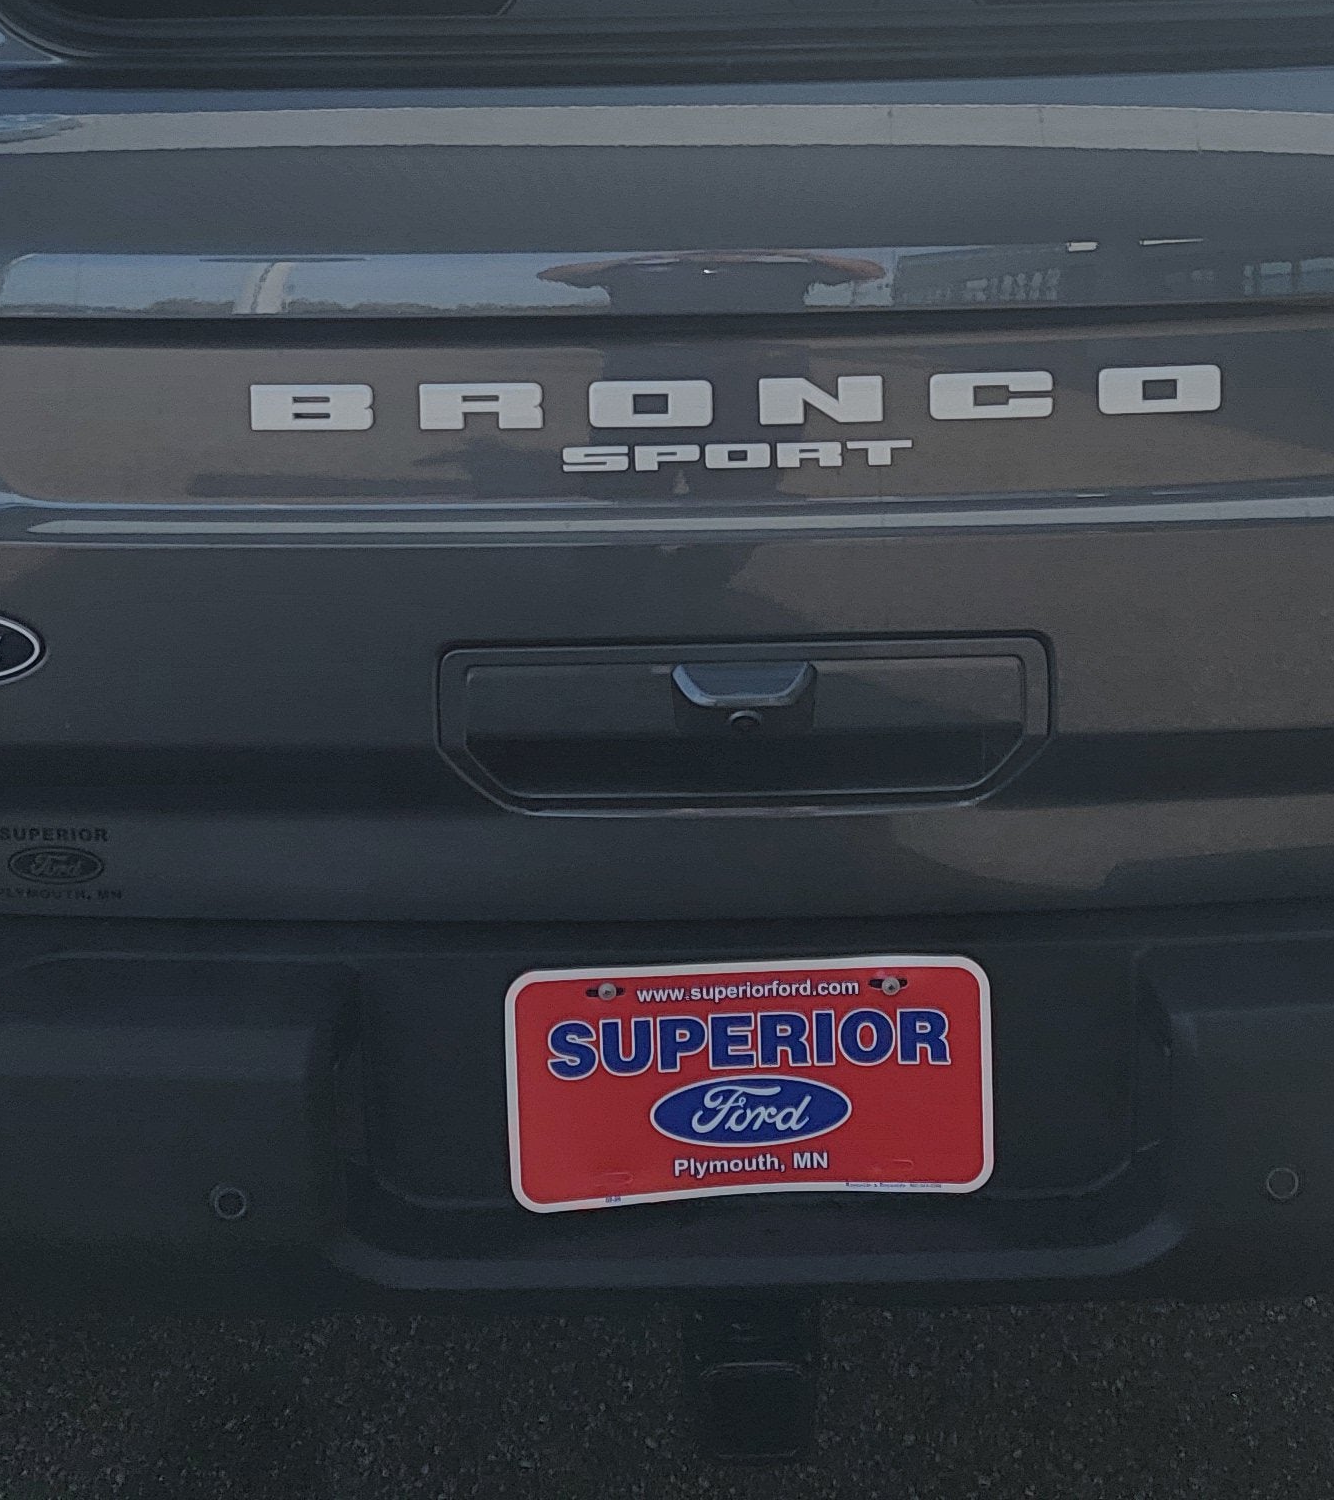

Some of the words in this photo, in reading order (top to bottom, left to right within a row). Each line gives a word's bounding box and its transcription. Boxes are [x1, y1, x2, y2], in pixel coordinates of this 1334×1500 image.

[247, 363, 1223, 431] BRONCO
[560, 438, 914, 473] SPORT
[636, 978, 860, 1004] www.superiorford.com
[547, 1008, 951, 1081] SUPERIOR
[691, 1085, 812, 1134] Ford
[674, 1153, 786, 1179] Plymouth,
[793, 1151, 828, 1169] MN
